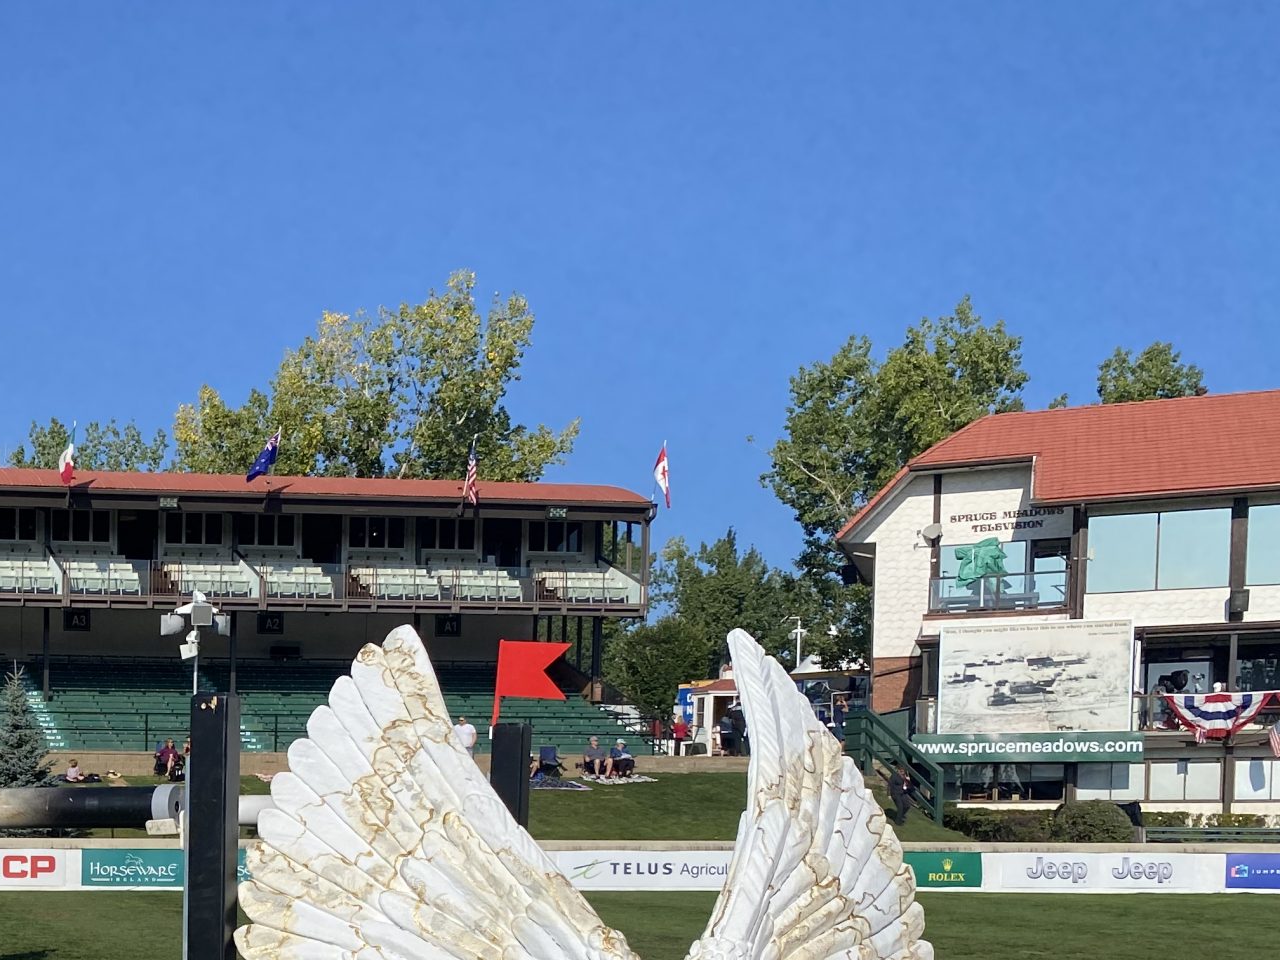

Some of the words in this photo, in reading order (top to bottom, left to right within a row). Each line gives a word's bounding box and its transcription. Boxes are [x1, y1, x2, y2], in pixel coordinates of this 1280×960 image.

[950, 511, 997, 523] SPRUCE
[1002, 507, 1065, 519] MEADOWS
[971, 520, 1044, 533] TELEVISION
[71, 615, 86, 627] A3
[265, 618, 280, 630] A2
[444, 621, 457, 632] A1
[912, 738, 1144, 757] www.sprucemeadows.com
[2, 855, 56, 879] CP
[90, 861, 178, 877] HORSEWARE
[609, 862, 673, 875] TELUS
[680, 863, 728, 878] Agricul
[1026, 857, 1088, 883] Jeep
[1112, 857, 1173, 883] Jeep
[928, 872, 966, 882] ROLEX
